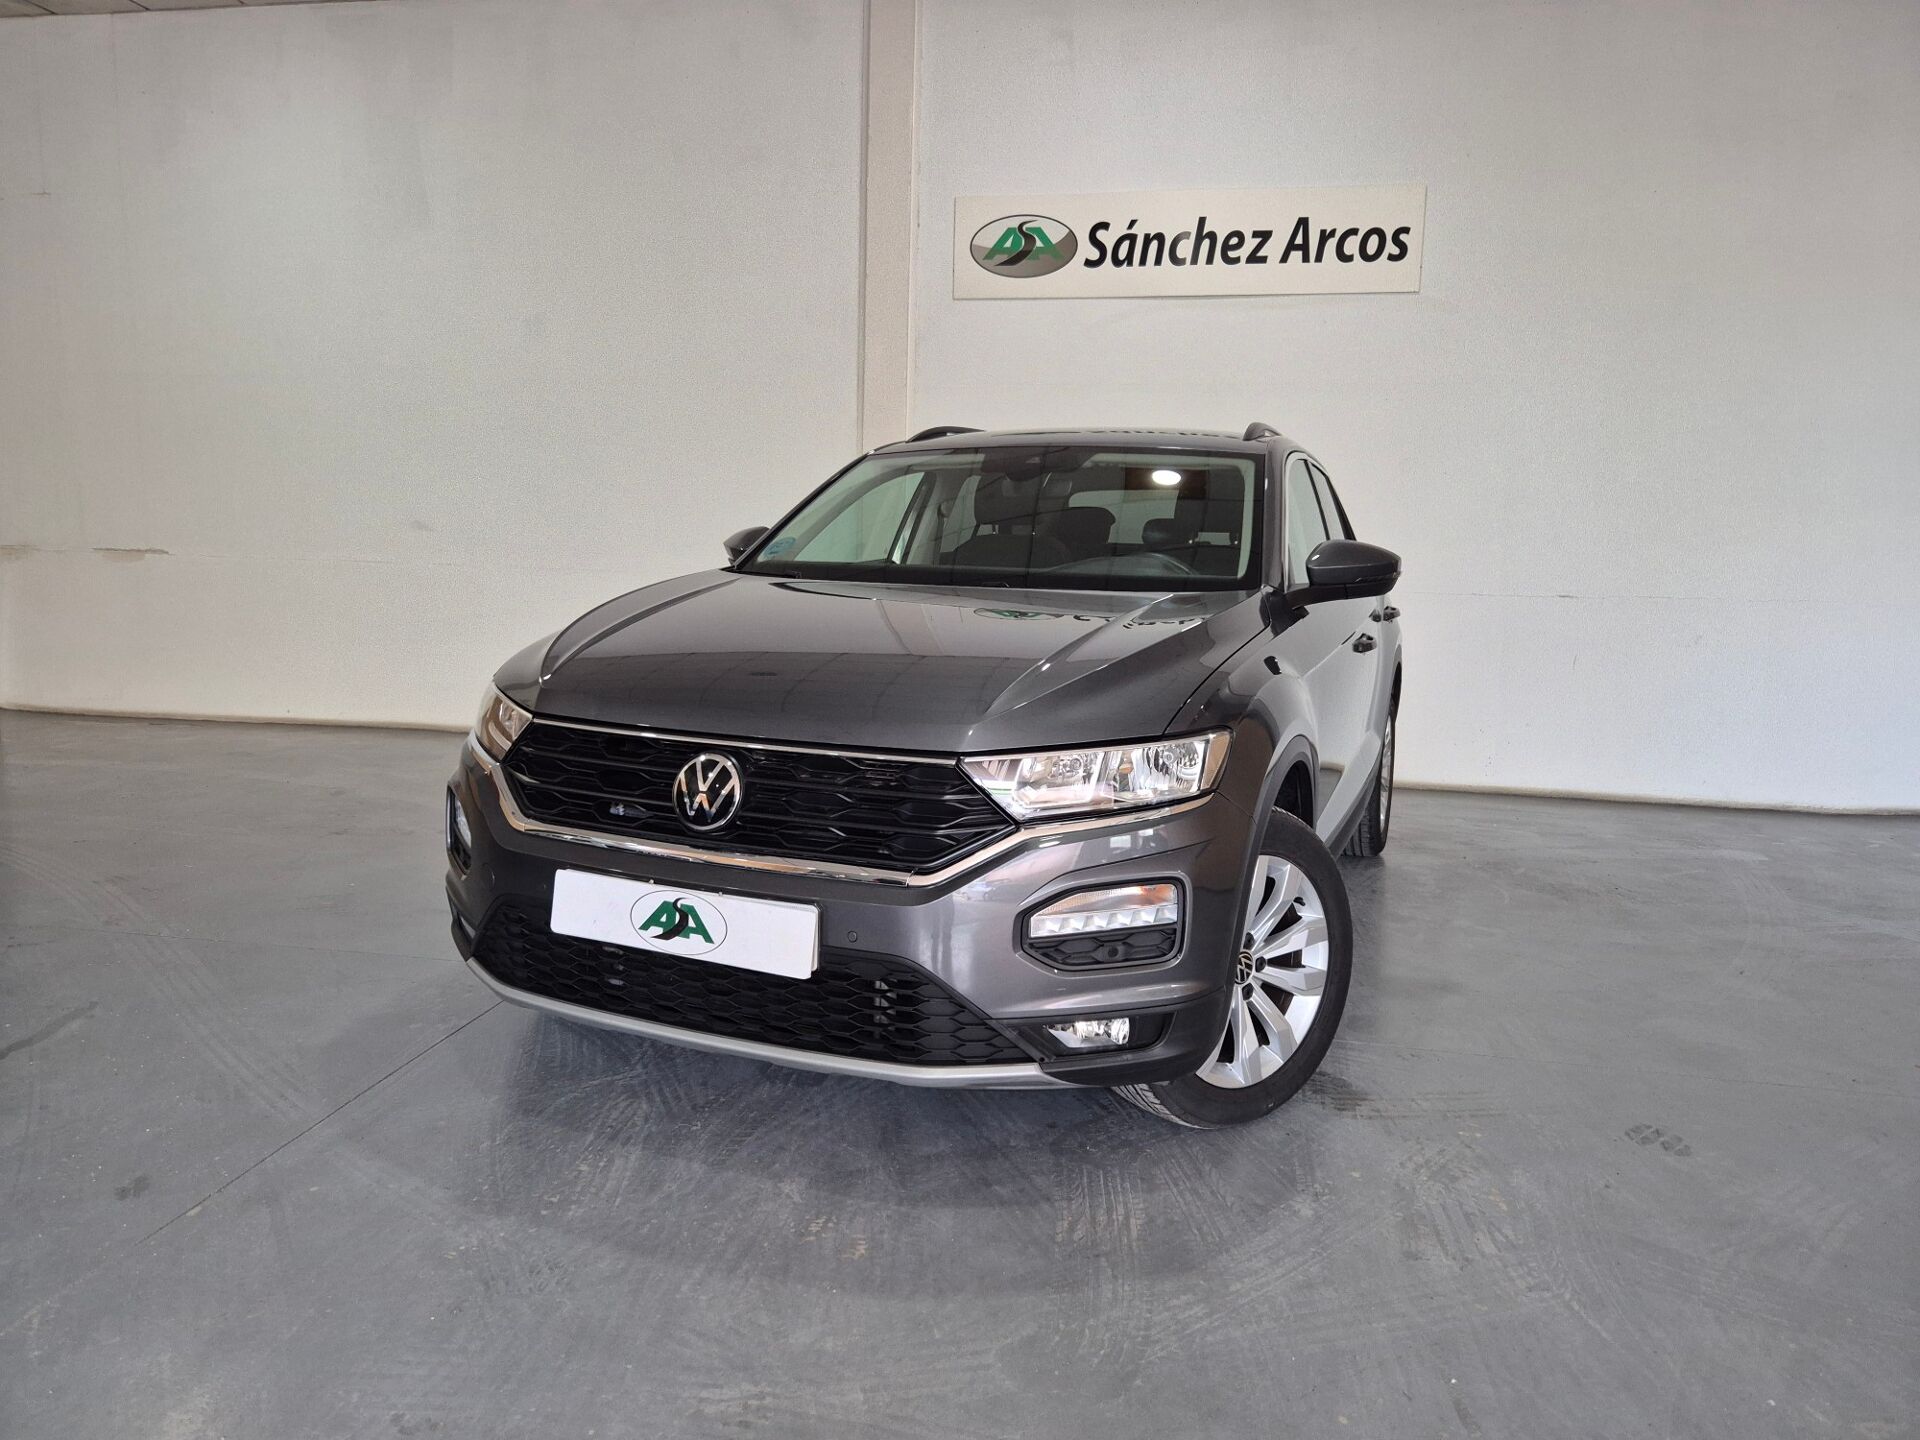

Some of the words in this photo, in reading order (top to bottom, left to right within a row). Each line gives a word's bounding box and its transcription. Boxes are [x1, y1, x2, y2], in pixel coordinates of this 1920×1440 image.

[1083, 216, 1272, 269] Sánchez
[1279, 216, 1411, 264] Arcos
[676, 754, 740, 825] VW
